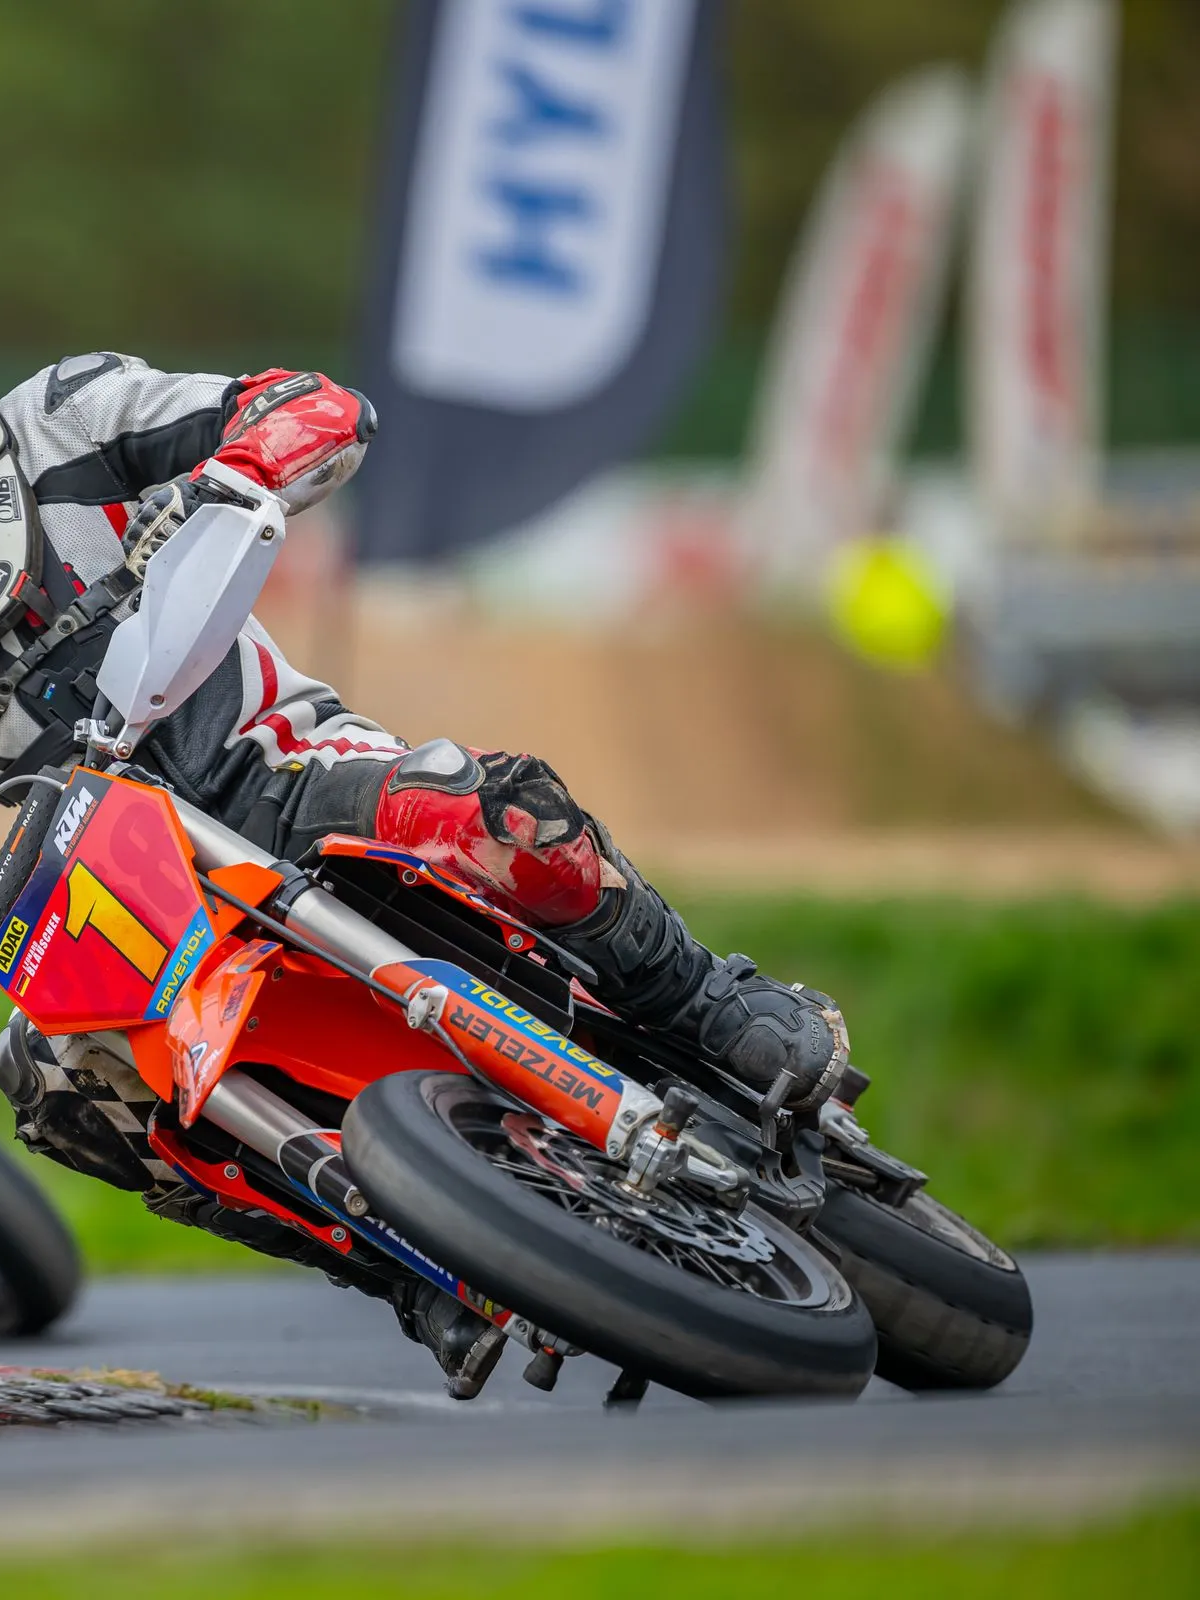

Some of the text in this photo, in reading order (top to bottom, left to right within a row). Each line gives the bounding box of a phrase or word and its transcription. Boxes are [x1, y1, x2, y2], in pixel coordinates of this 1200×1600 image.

[3, 853, 12, 867] TO
[22, 800, 39, 827] RACE
[54, 786, 94, 855] KTM
[26, 912, 61, 977] BLAUSCHEK
[63, 857, 171, 986] 1
[156, 926, 207, 1014] RAVENOL
[450, 1005, 605, 1110] METZELER
[469, 978, 616, 1077] RAVENOL
